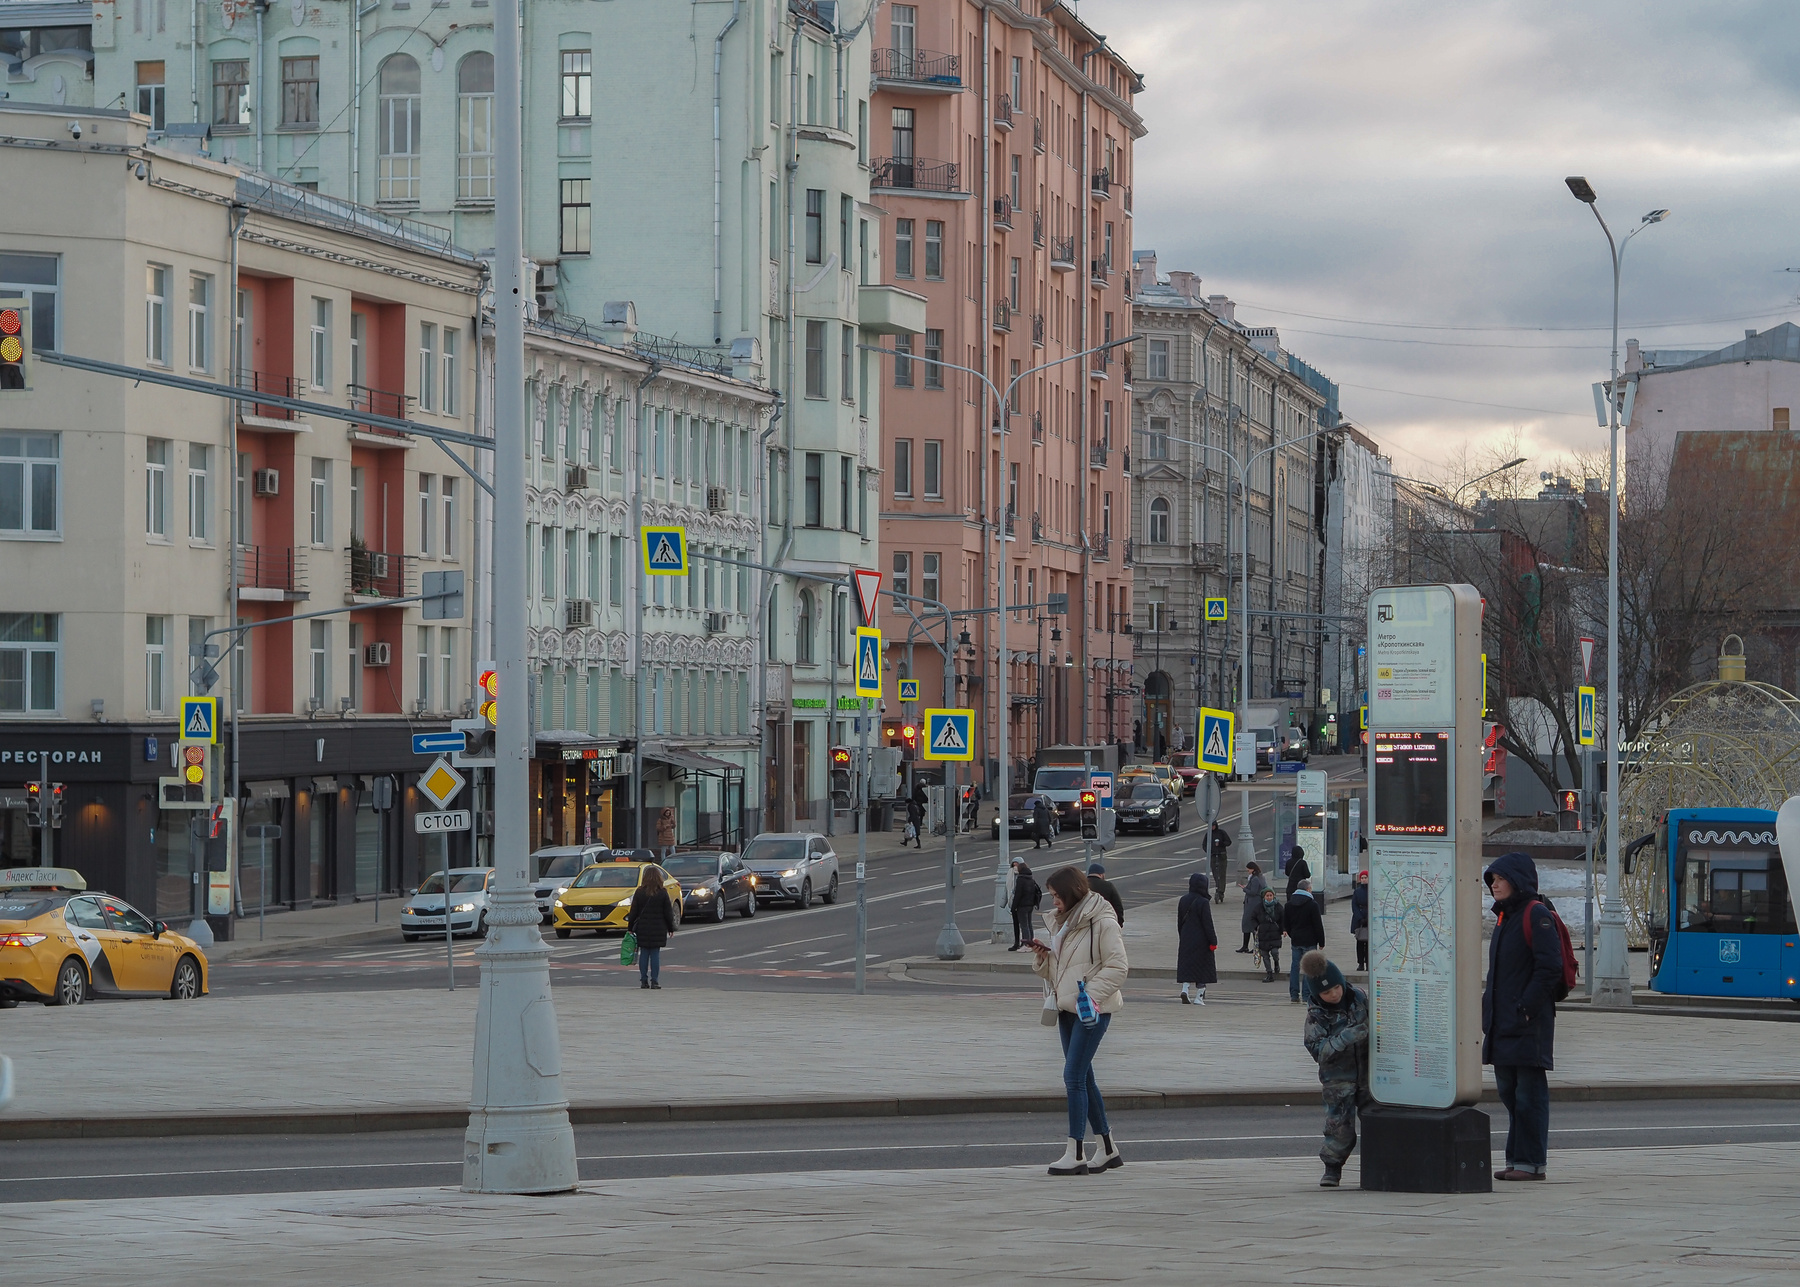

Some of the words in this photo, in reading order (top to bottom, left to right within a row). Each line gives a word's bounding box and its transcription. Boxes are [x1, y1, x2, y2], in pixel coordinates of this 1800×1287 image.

[2, 751, 102, 763] РЕСТОРАН
[562, 750, 582, 760] РЕСТОРАН
[598, 748, 617, 759] ПИЦЦЕРИЯ
[423, 814, 462, 829] СТОП
[611, 849, 635, 857] Uber
[5, 870, 34, 883] Яндекс
[35, 869, 57, 881] Такси
